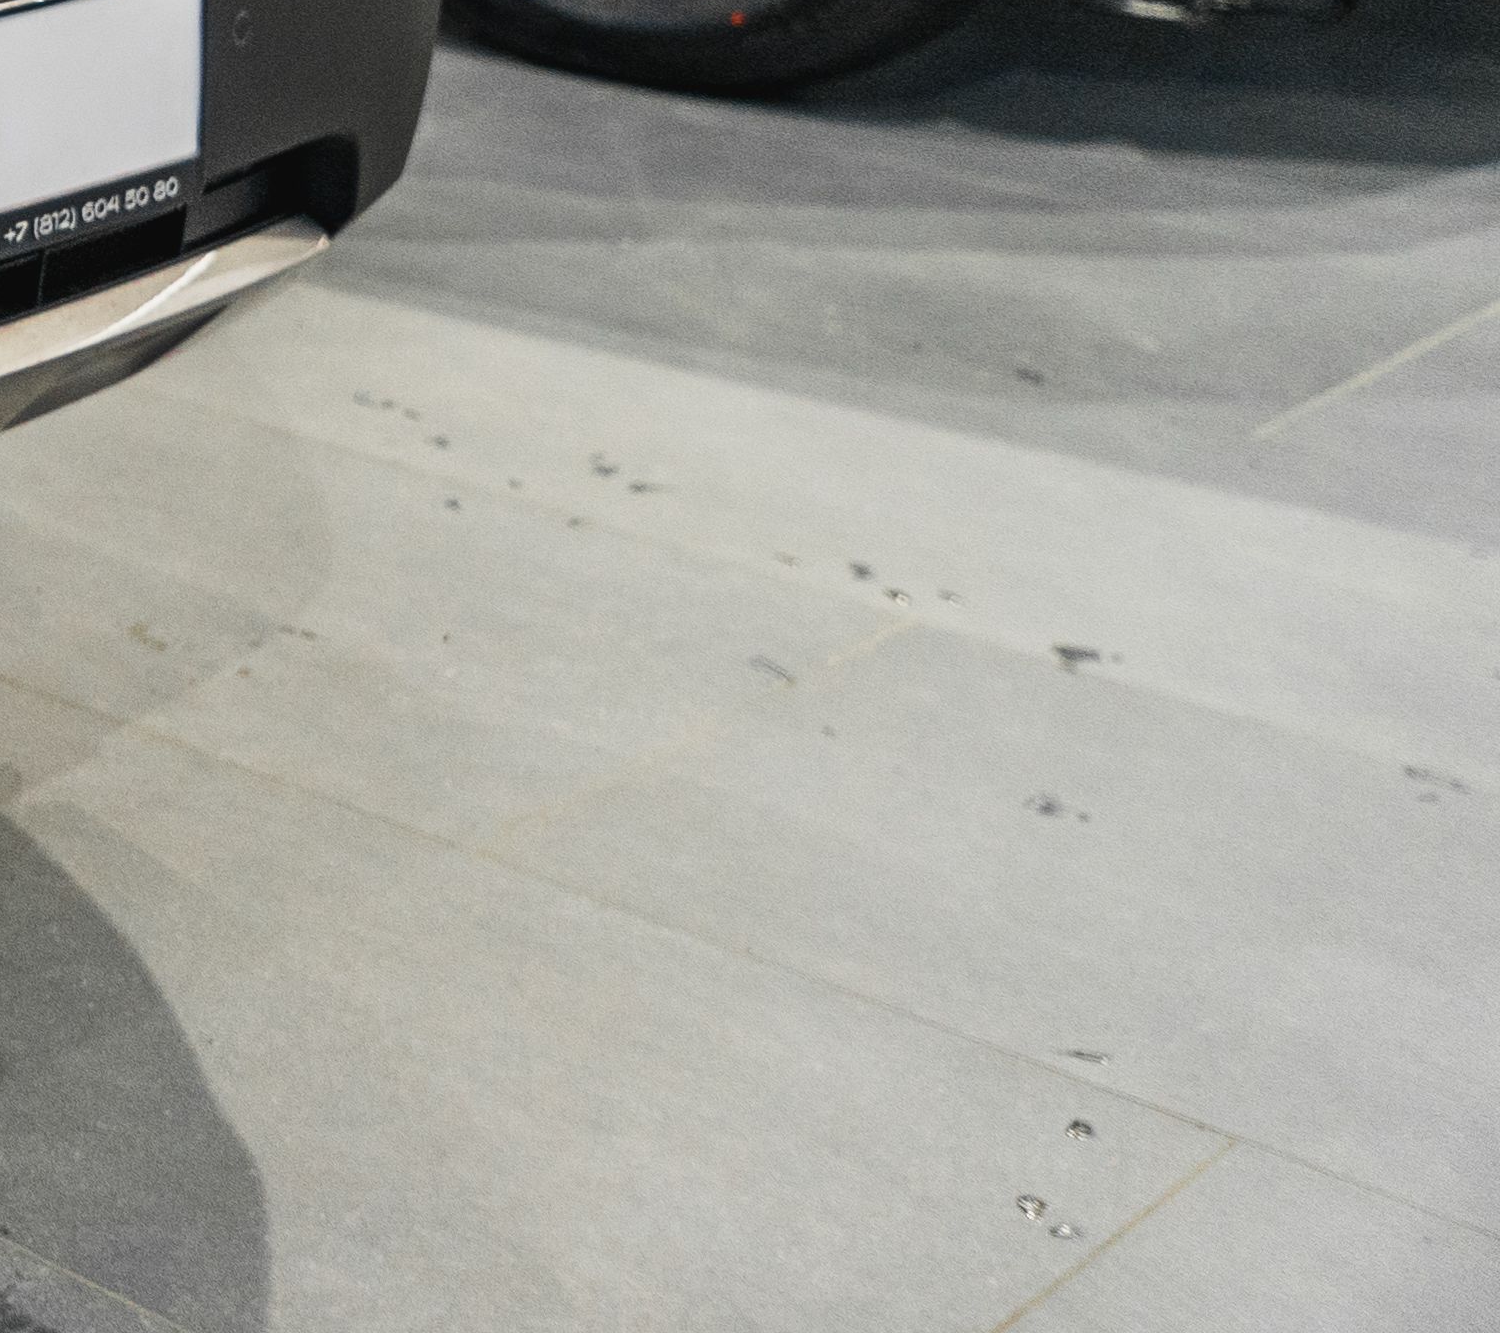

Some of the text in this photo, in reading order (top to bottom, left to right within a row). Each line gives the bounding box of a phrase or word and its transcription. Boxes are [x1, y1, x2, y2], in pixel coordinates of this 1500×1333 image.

[3, 220, 29, 244] +7
[33, 206, 77, 241] (812)
[81, 194, 120, 223] 604
[152, 175, 180, 203] 80
